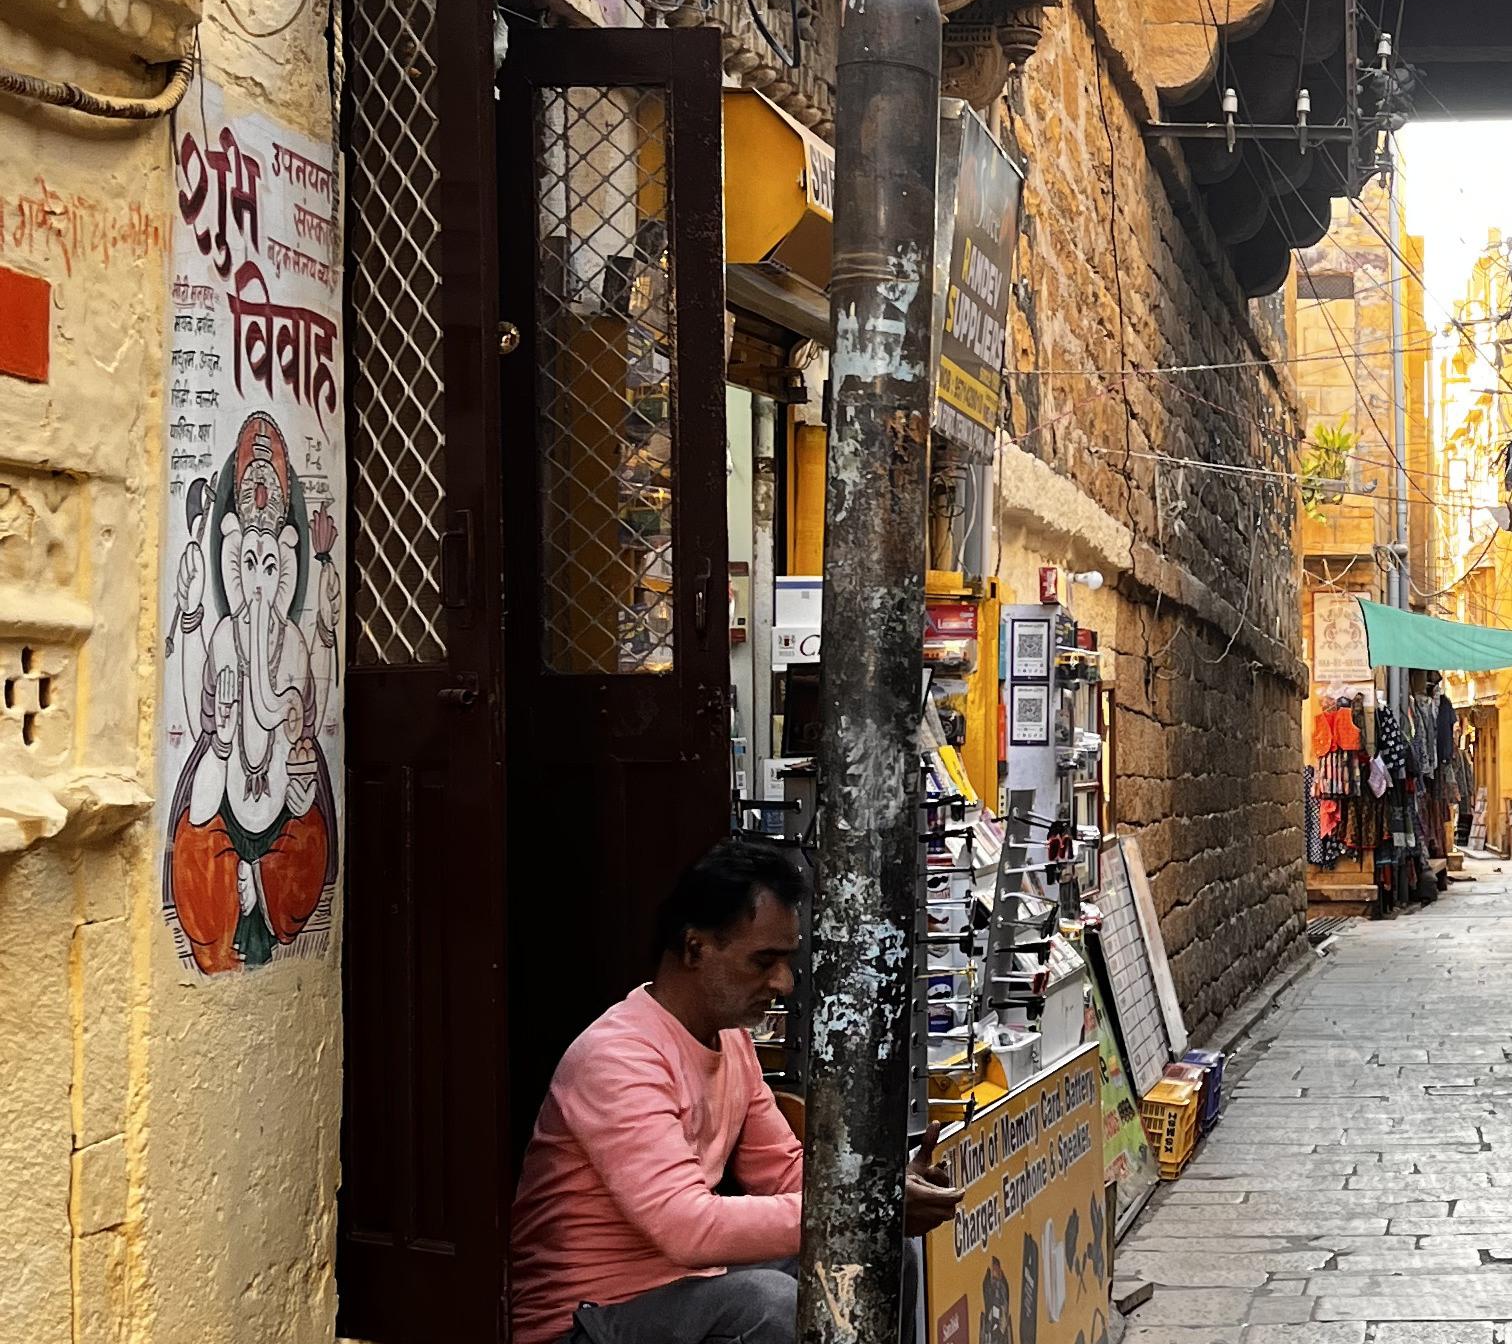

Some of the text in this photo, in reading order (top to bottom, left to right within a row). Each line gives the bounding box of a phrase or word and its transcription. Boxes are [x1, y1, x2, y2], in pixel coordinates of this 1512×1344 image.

[178, 126, 261, 278] शुभ
[271, 142, 333, 204] उपनयन
[226, 260, 338, 445] विवाह
[946, 284, 1005, 374] SUPPLIERS
[959, 1135, 986, 1186] Kind
[988, 1123, 999, 1168] of
[1001, 1104, 1039, 1158] Memory
[954, 1193, 1001, 1260] Charger,
[1003, 1154, 1047, 1217] Earphone
[1049, 1140, 1056, 1179] &
